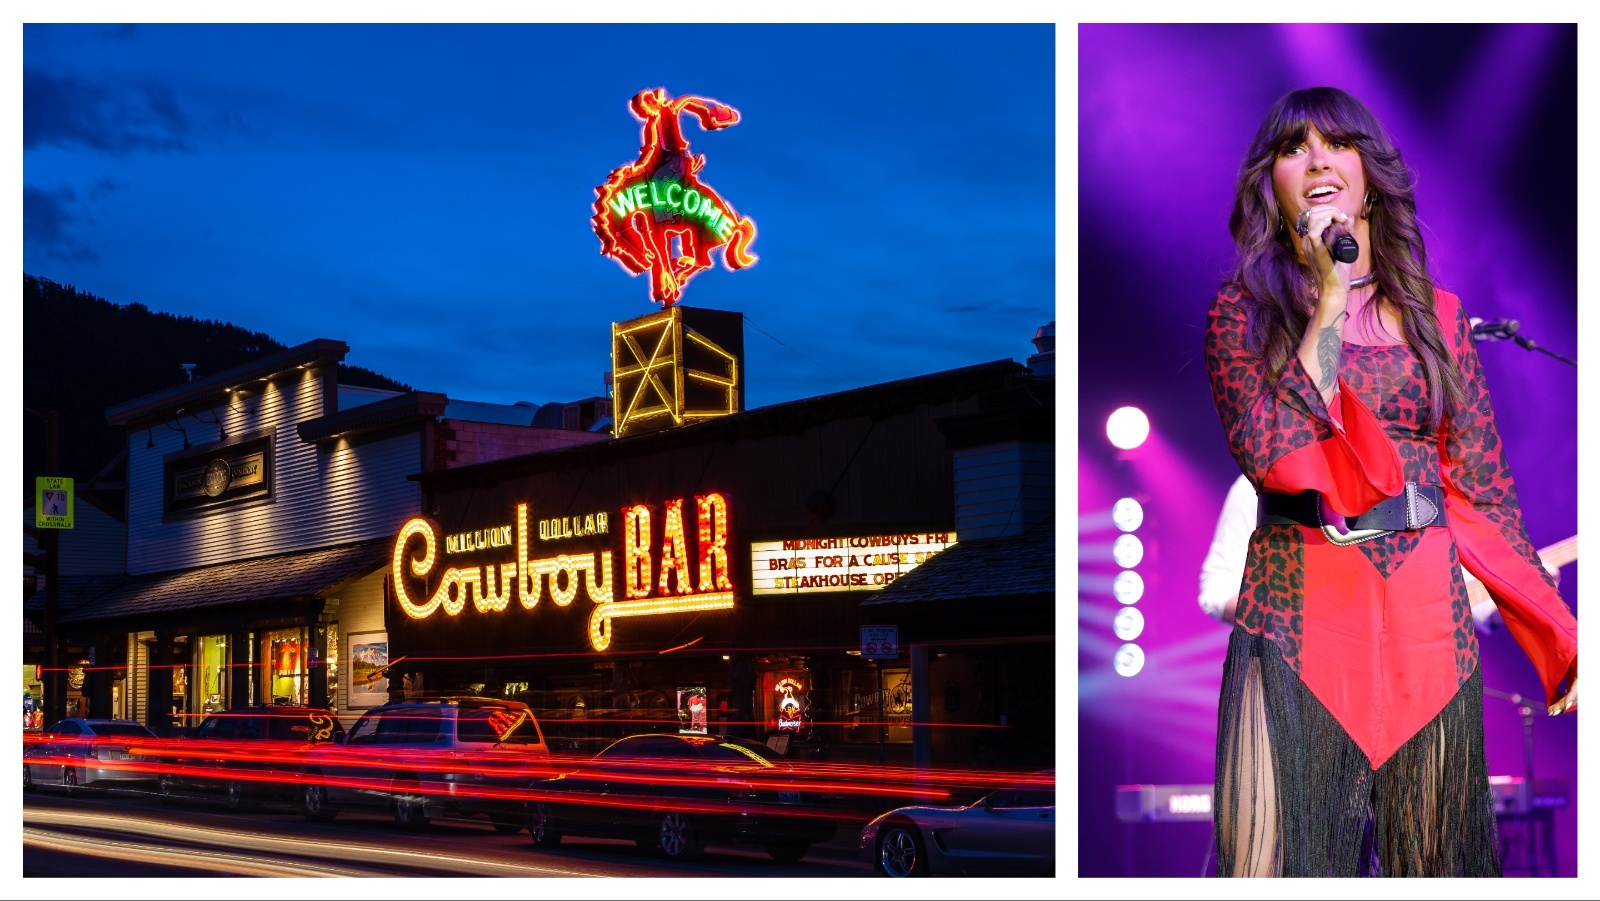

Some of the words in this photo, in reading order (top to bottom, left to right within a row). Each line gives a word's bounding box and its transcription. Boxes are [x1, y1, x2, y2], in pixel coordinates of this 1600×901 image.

[608, 181, 736, 242] WELCOME
[56, 493, 65, 502] TO
[446, 524, 513, 554] MILLION
[539, 511, 609, 541] DOLLAR
[782, 537, 844, 551] MIDNIGHT
[849, 534, 919, 549] COWBOYS
[926, 532, 949, 544] FRI
[768, 556, 807, 571] BRAS
[815, 555, 843, 569] FOR
[848, 554, 859, 567] A
[864, 552, 909, 566] CAUSE
[915, 550, 940, 565] SA
[393, 503, 613, 651] Cowboy
[620, 492, 733, 599] BAR
[774, 573, 868, 590] STEAKHOUSE
[778, 718, 802, 727] Budweiser
[1168, 794, 1211, 813] KORG
